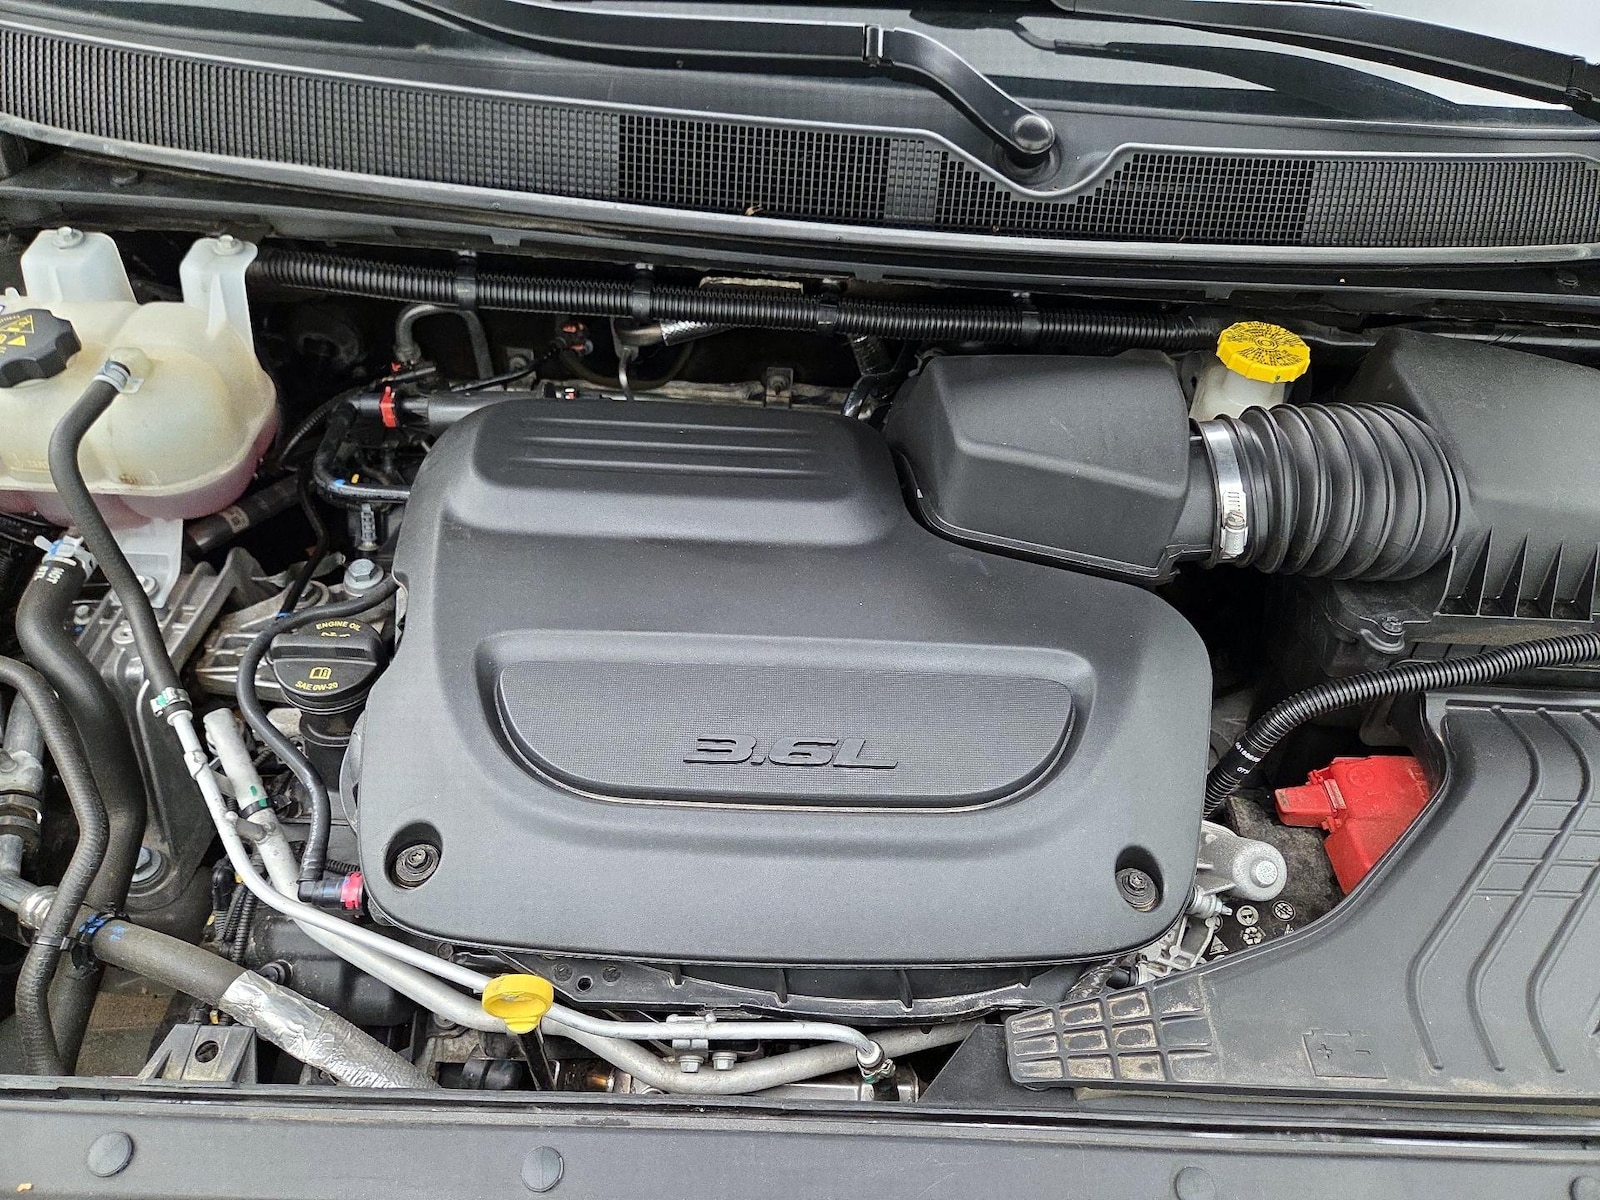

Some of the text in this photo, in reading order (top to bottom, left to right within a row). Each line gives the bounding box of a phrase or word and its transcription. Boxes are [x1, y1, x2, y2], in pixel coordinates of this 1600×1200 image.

[316, 621, 361, 631] ENGINE OIL
[295, 681, 338, 690] SAE 0W-20
[682, 733, 899, 770] 3.6L
